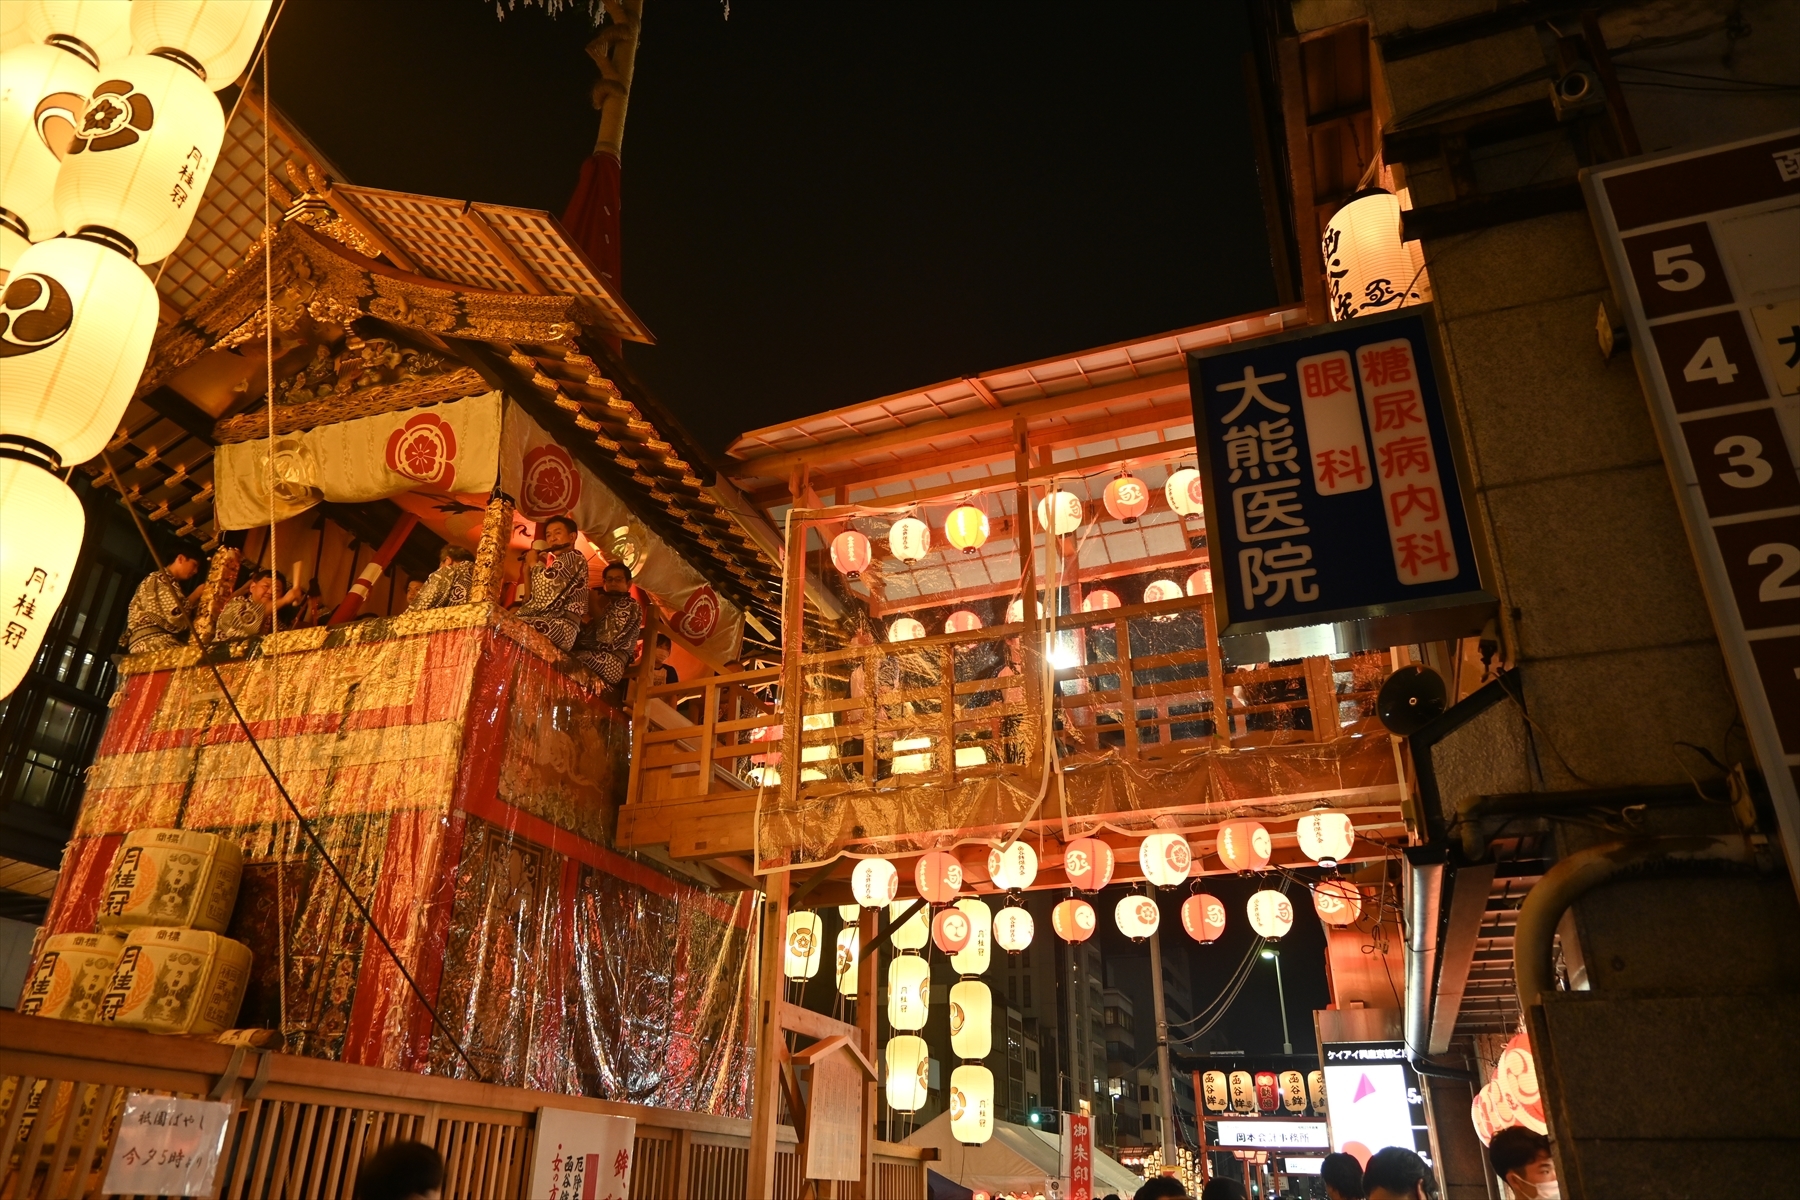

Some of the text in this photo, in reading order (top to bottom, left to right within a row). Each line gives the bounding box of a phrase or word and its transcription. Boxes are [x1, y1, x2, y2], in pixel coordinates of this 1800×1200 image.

[169, 145, 203, 209] 月桂冠
[1652, 243, 1707, 293] 5
[1683, 336, 1740, 386] 4
[1302, 357, 1366, 490] 眼科
[1215, 364, 1320, 611] 大熊医院
[1361, 345, 1453, 578] 糖尿病内科
[1713, 434, 1774, 490] 3
[1747, 541, 1800, 603] 2
[1, 566, 48, 650] 月桂冠
[102, 846, 145, 917] 月桂冠
[97, 945, 143, 1023] 月桂冠
